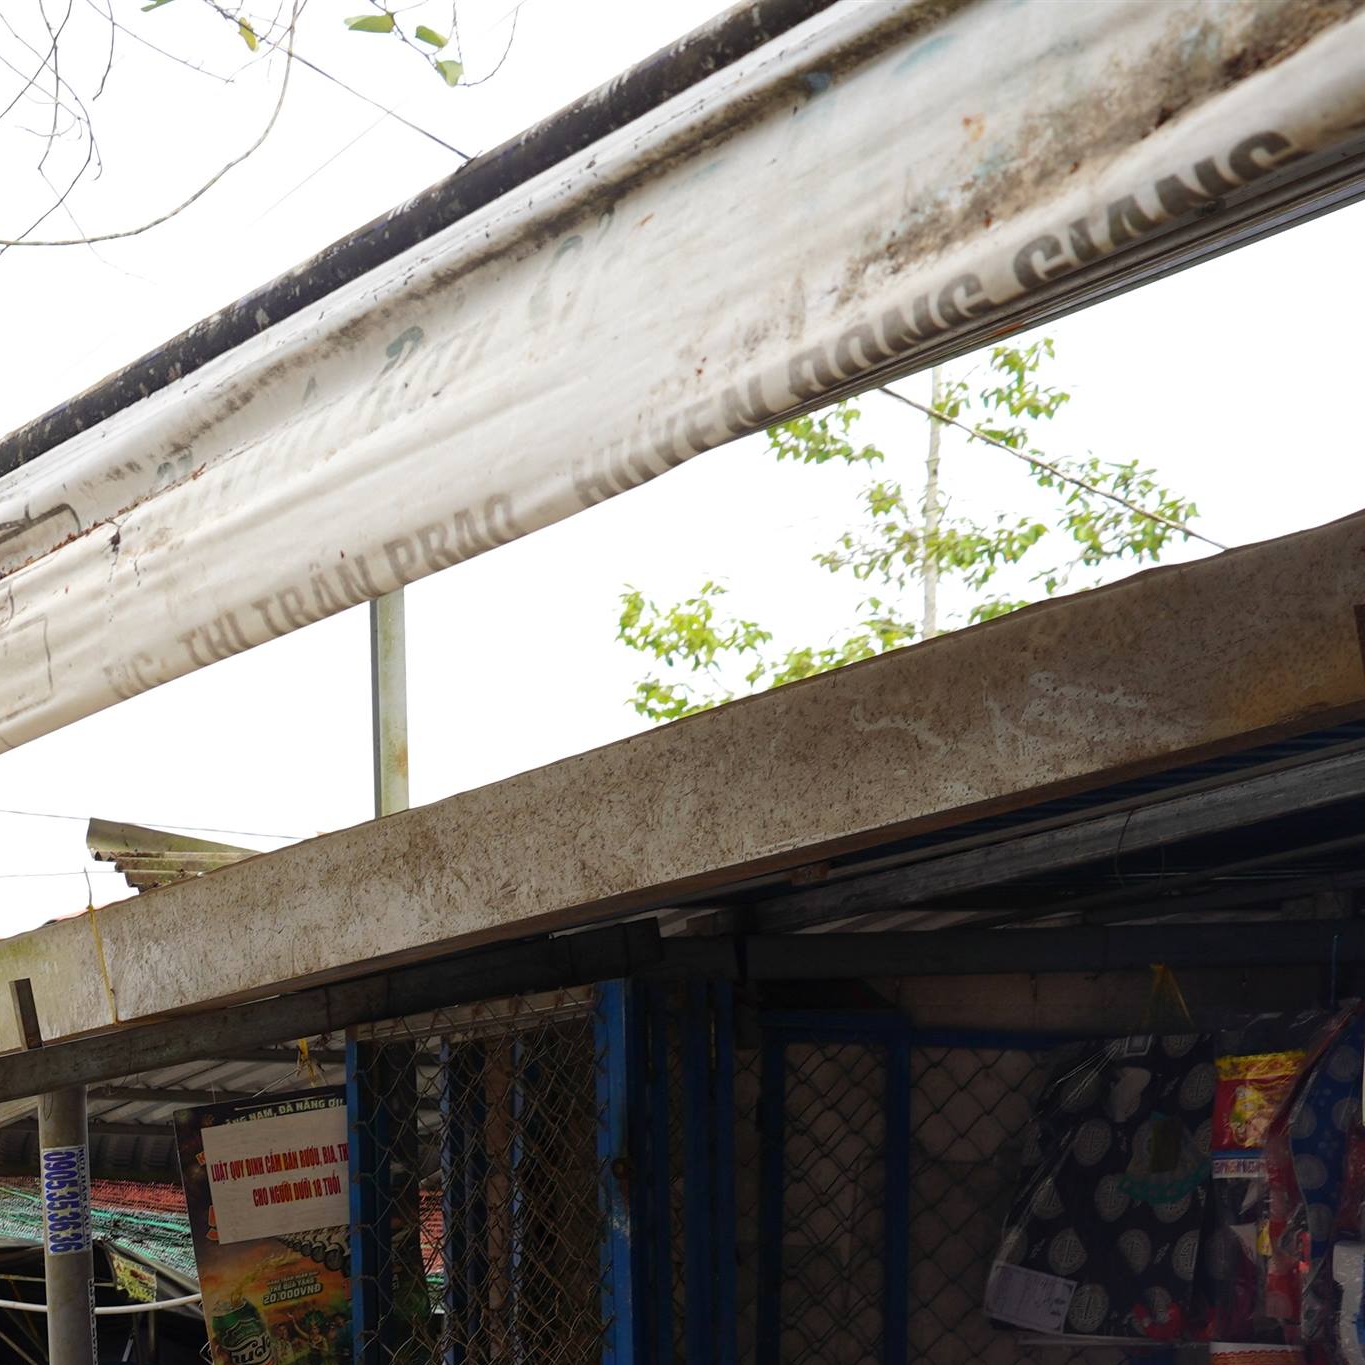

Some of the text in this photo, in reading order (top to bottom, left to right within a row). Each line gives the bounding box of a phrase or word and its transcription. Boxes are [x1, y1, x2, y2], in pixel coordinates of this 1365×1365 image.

[43, 1151, 84, 1253] 0905.35.36.36
[252, 1188, 269, 1207] CHO
[313, 1180, 322, 1197] 18
